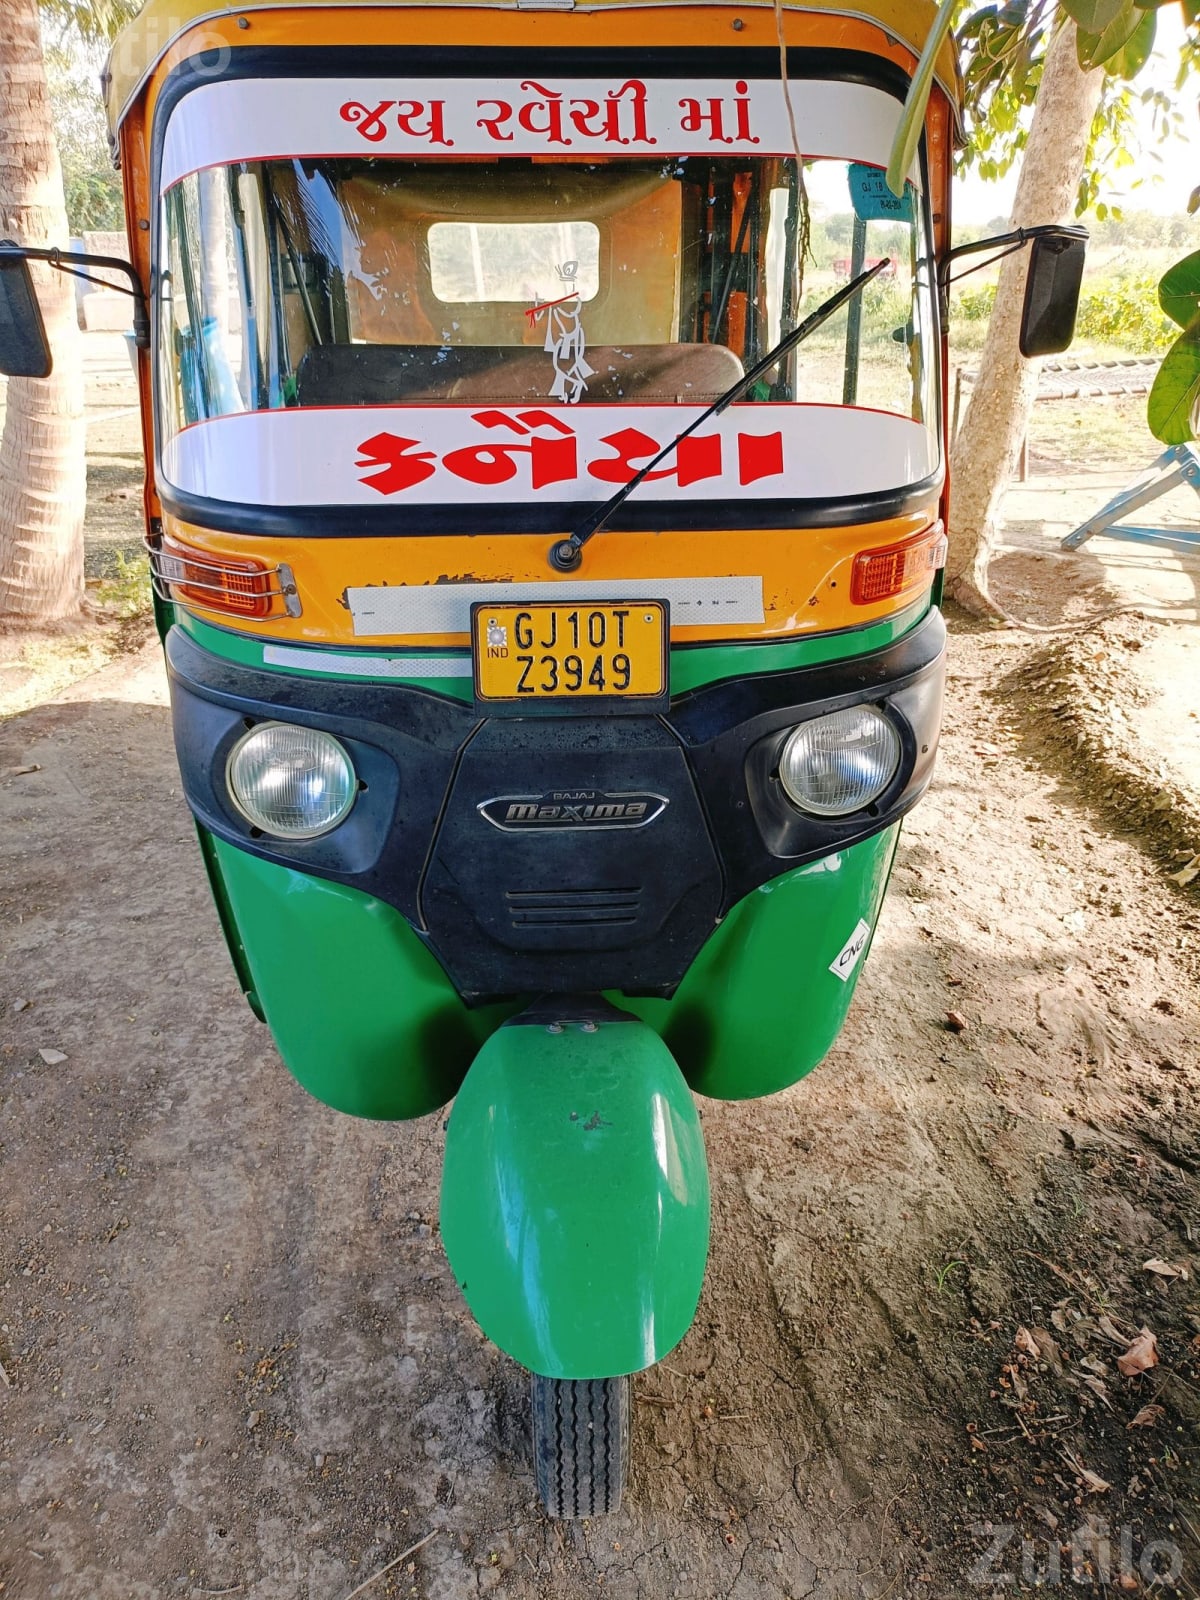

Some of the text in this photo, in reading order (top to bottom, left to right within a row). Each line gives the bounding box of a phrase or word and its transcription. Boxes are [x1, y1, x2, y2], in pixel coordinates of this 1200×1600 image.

[339, 99, 454, 147] જય
[678, 80, 760, 145] માં
[354, 410, 783, 496] કનૈયા
[514, 610, 630, 649] GJ10T
[487, 647, 508, 658] IND
[516, 654, 631, 693] Z3949
[553, 791, 595, 800] BAJAJ
